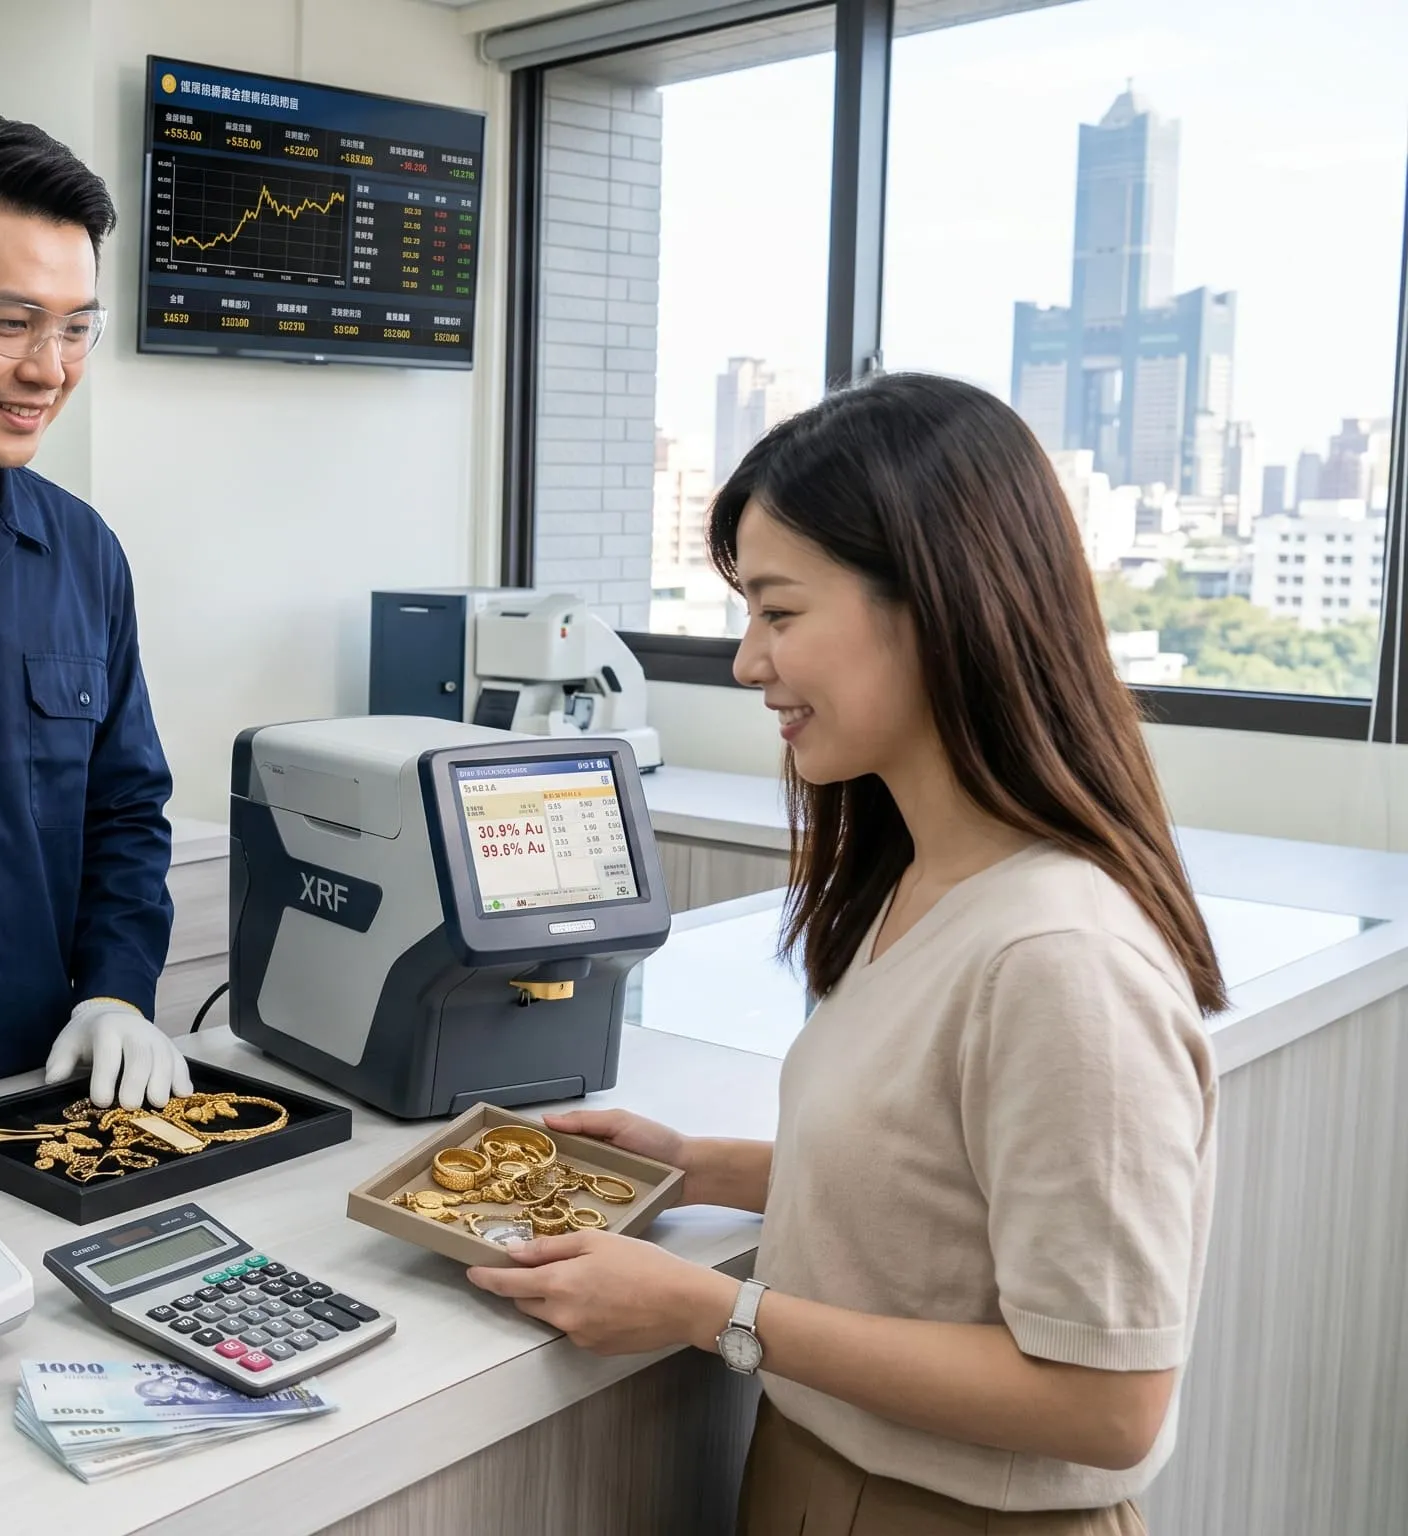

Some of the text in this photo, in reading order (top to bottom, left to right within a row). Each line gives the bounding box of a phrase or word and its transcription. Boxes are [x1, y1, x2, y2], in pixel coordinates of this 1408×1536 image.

[478, 822, 544, 839] 30.9% Au
[481, 841, 545, 858] 99.6% Au
[300, 872, 349, 913] XRF
[35, 1362, 105, 1375] 1000
[51, 1407, 105, 1416] 1000
[68, 1426, 121, 1438] 1000
